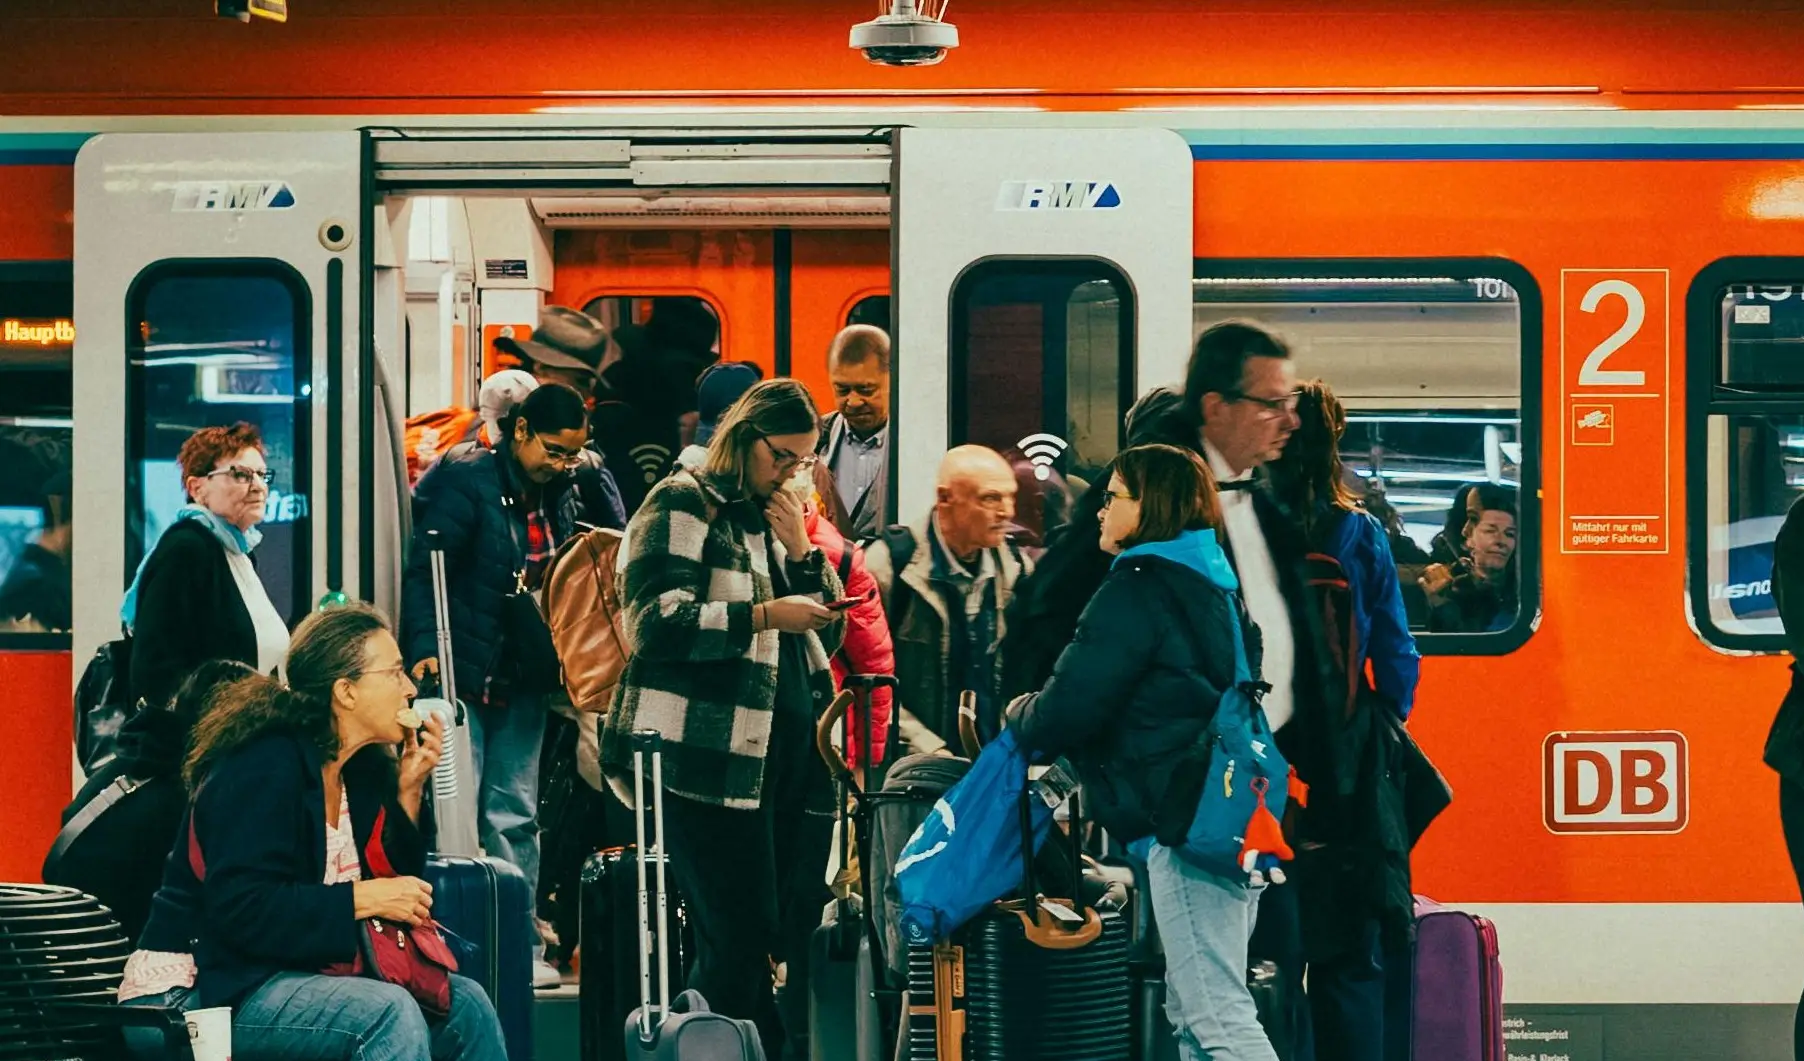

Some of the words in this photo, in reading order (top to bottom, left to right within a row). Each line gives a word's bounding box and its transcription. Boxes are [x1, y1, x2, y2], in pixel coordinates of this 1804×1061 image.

[194, 182, 283, 209] RMV
[1018, 182, 1109, 208] RMV
[4, 320, 76, 345] Hauptb
[1578, 279, 1645, 386] 2
[1572, 522, 1611, 532] Mitfahrt
[1613, 524, 1629, 532] nur
[1631, 522, 1647, 532] mit
[1572, 534, 1610, 546] gültiger
[1611, 533, 1659, 544] Fahrkarte
[1563, 749, 1670, 816] DB
